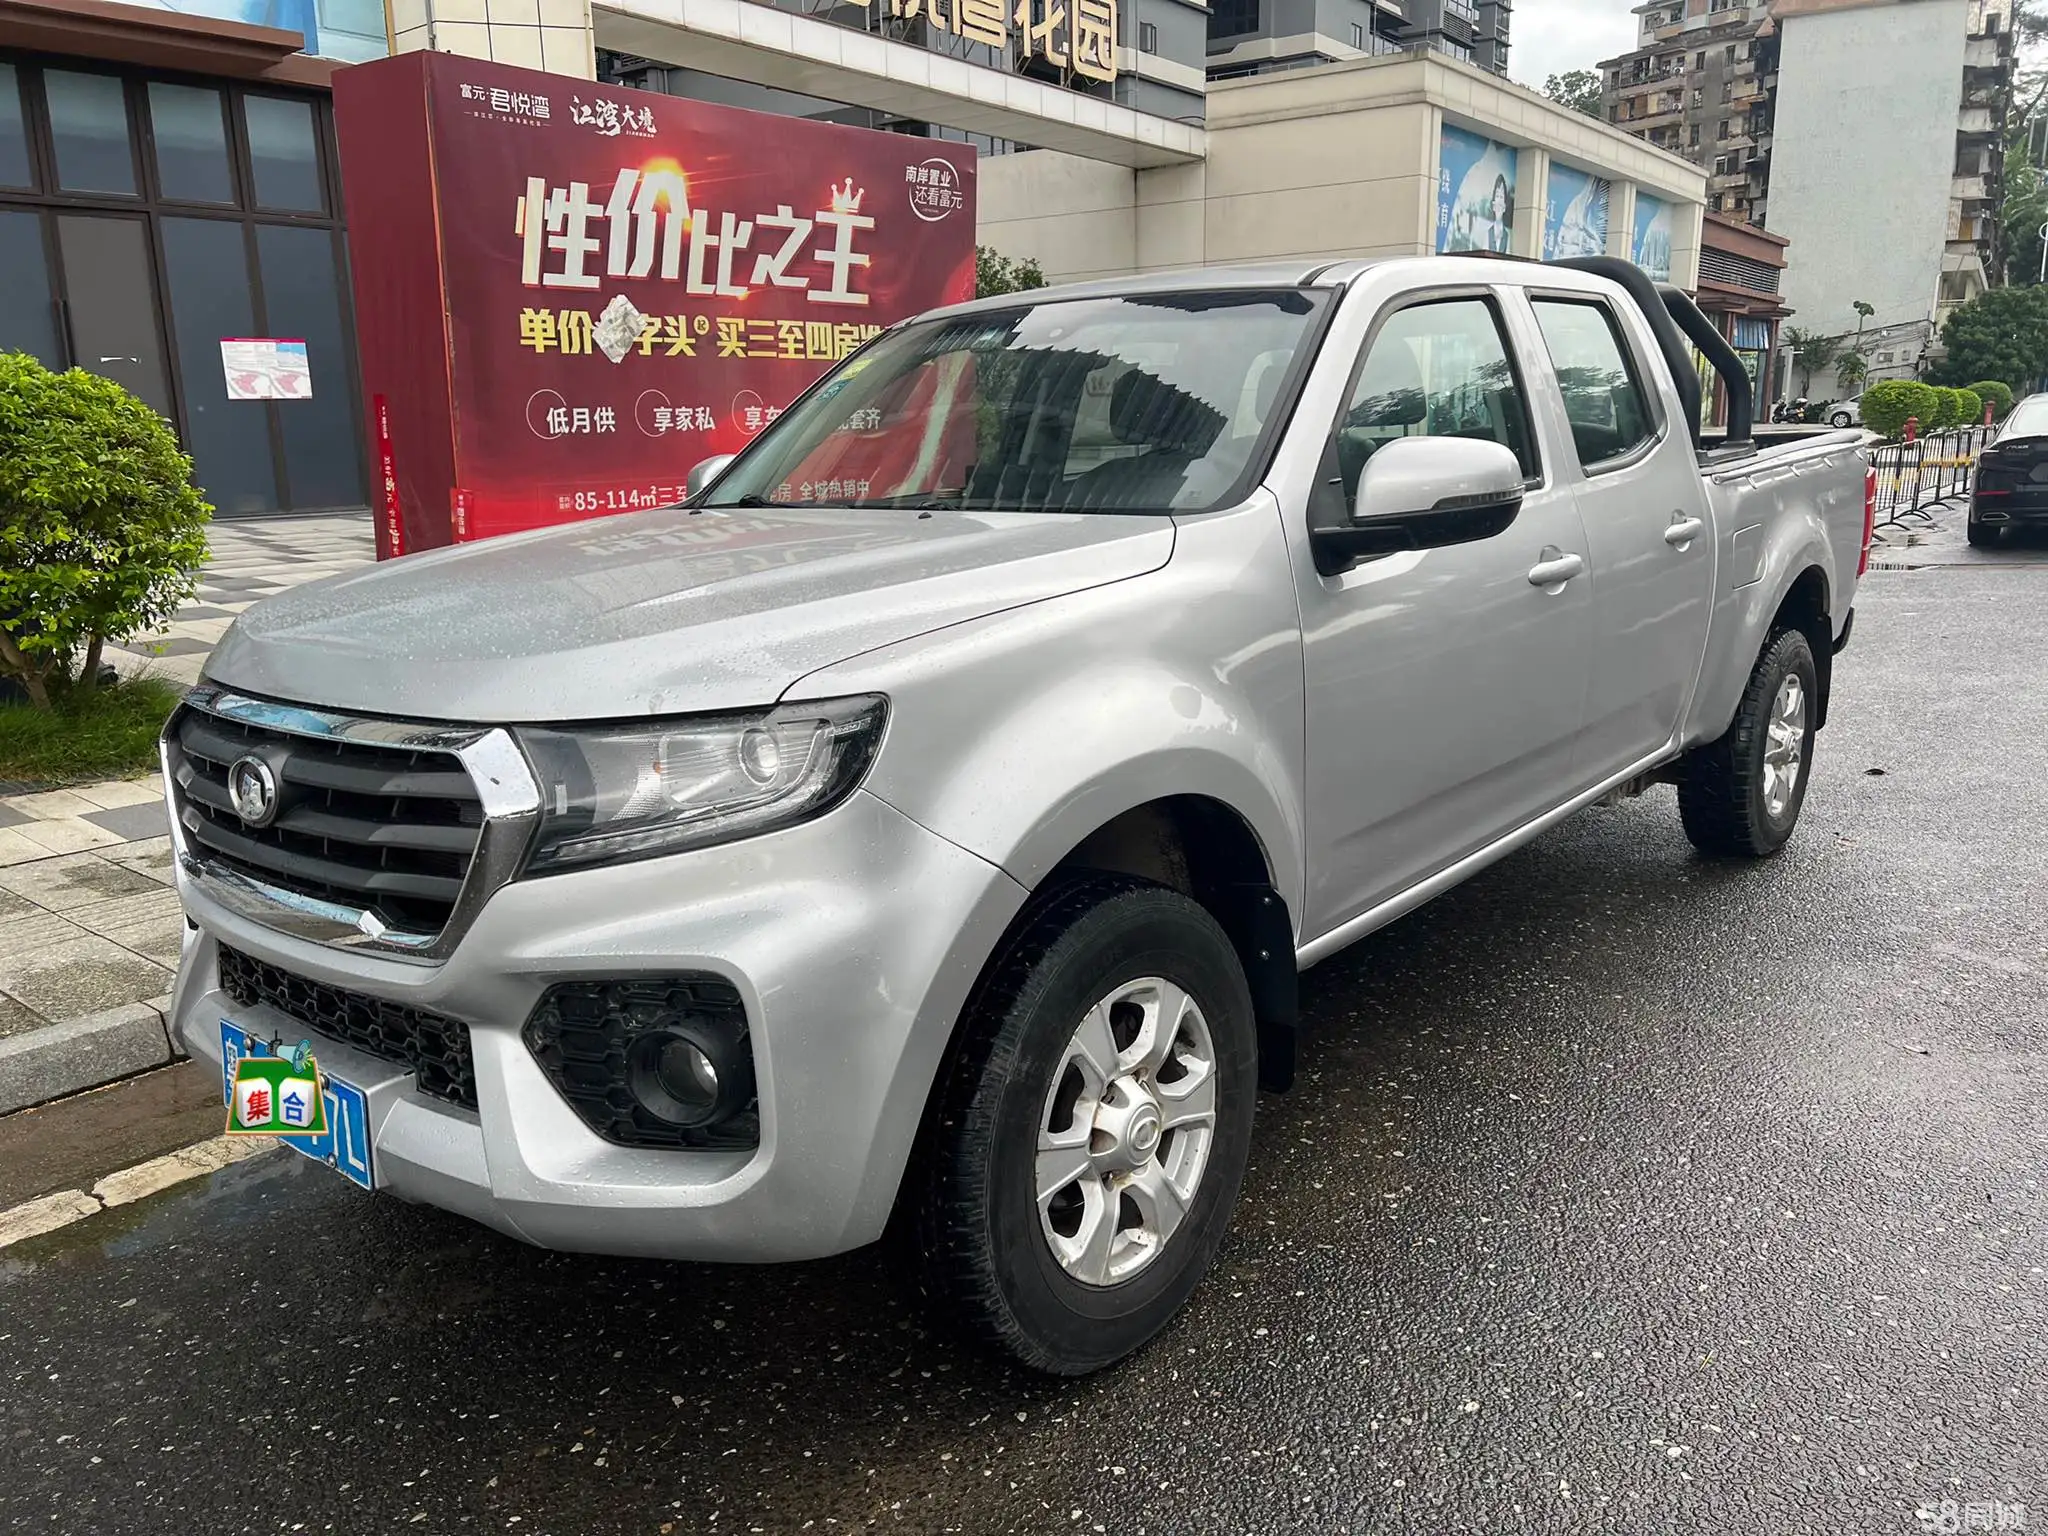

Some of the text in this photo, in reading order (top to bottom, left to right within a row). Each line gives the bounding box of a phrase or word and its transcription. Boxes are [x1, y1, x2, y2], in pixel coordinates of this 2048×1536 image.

[905, 165, 951, 188] 南岸置业
[914, 185, 963, 209] 还看富元
[520, 306, 697, 358] 单价字头
[546, 406, 616, 434] 低月供
[653, 405, 716, 432] 享家私
[799, 478, 870, 501] 全城热销中
